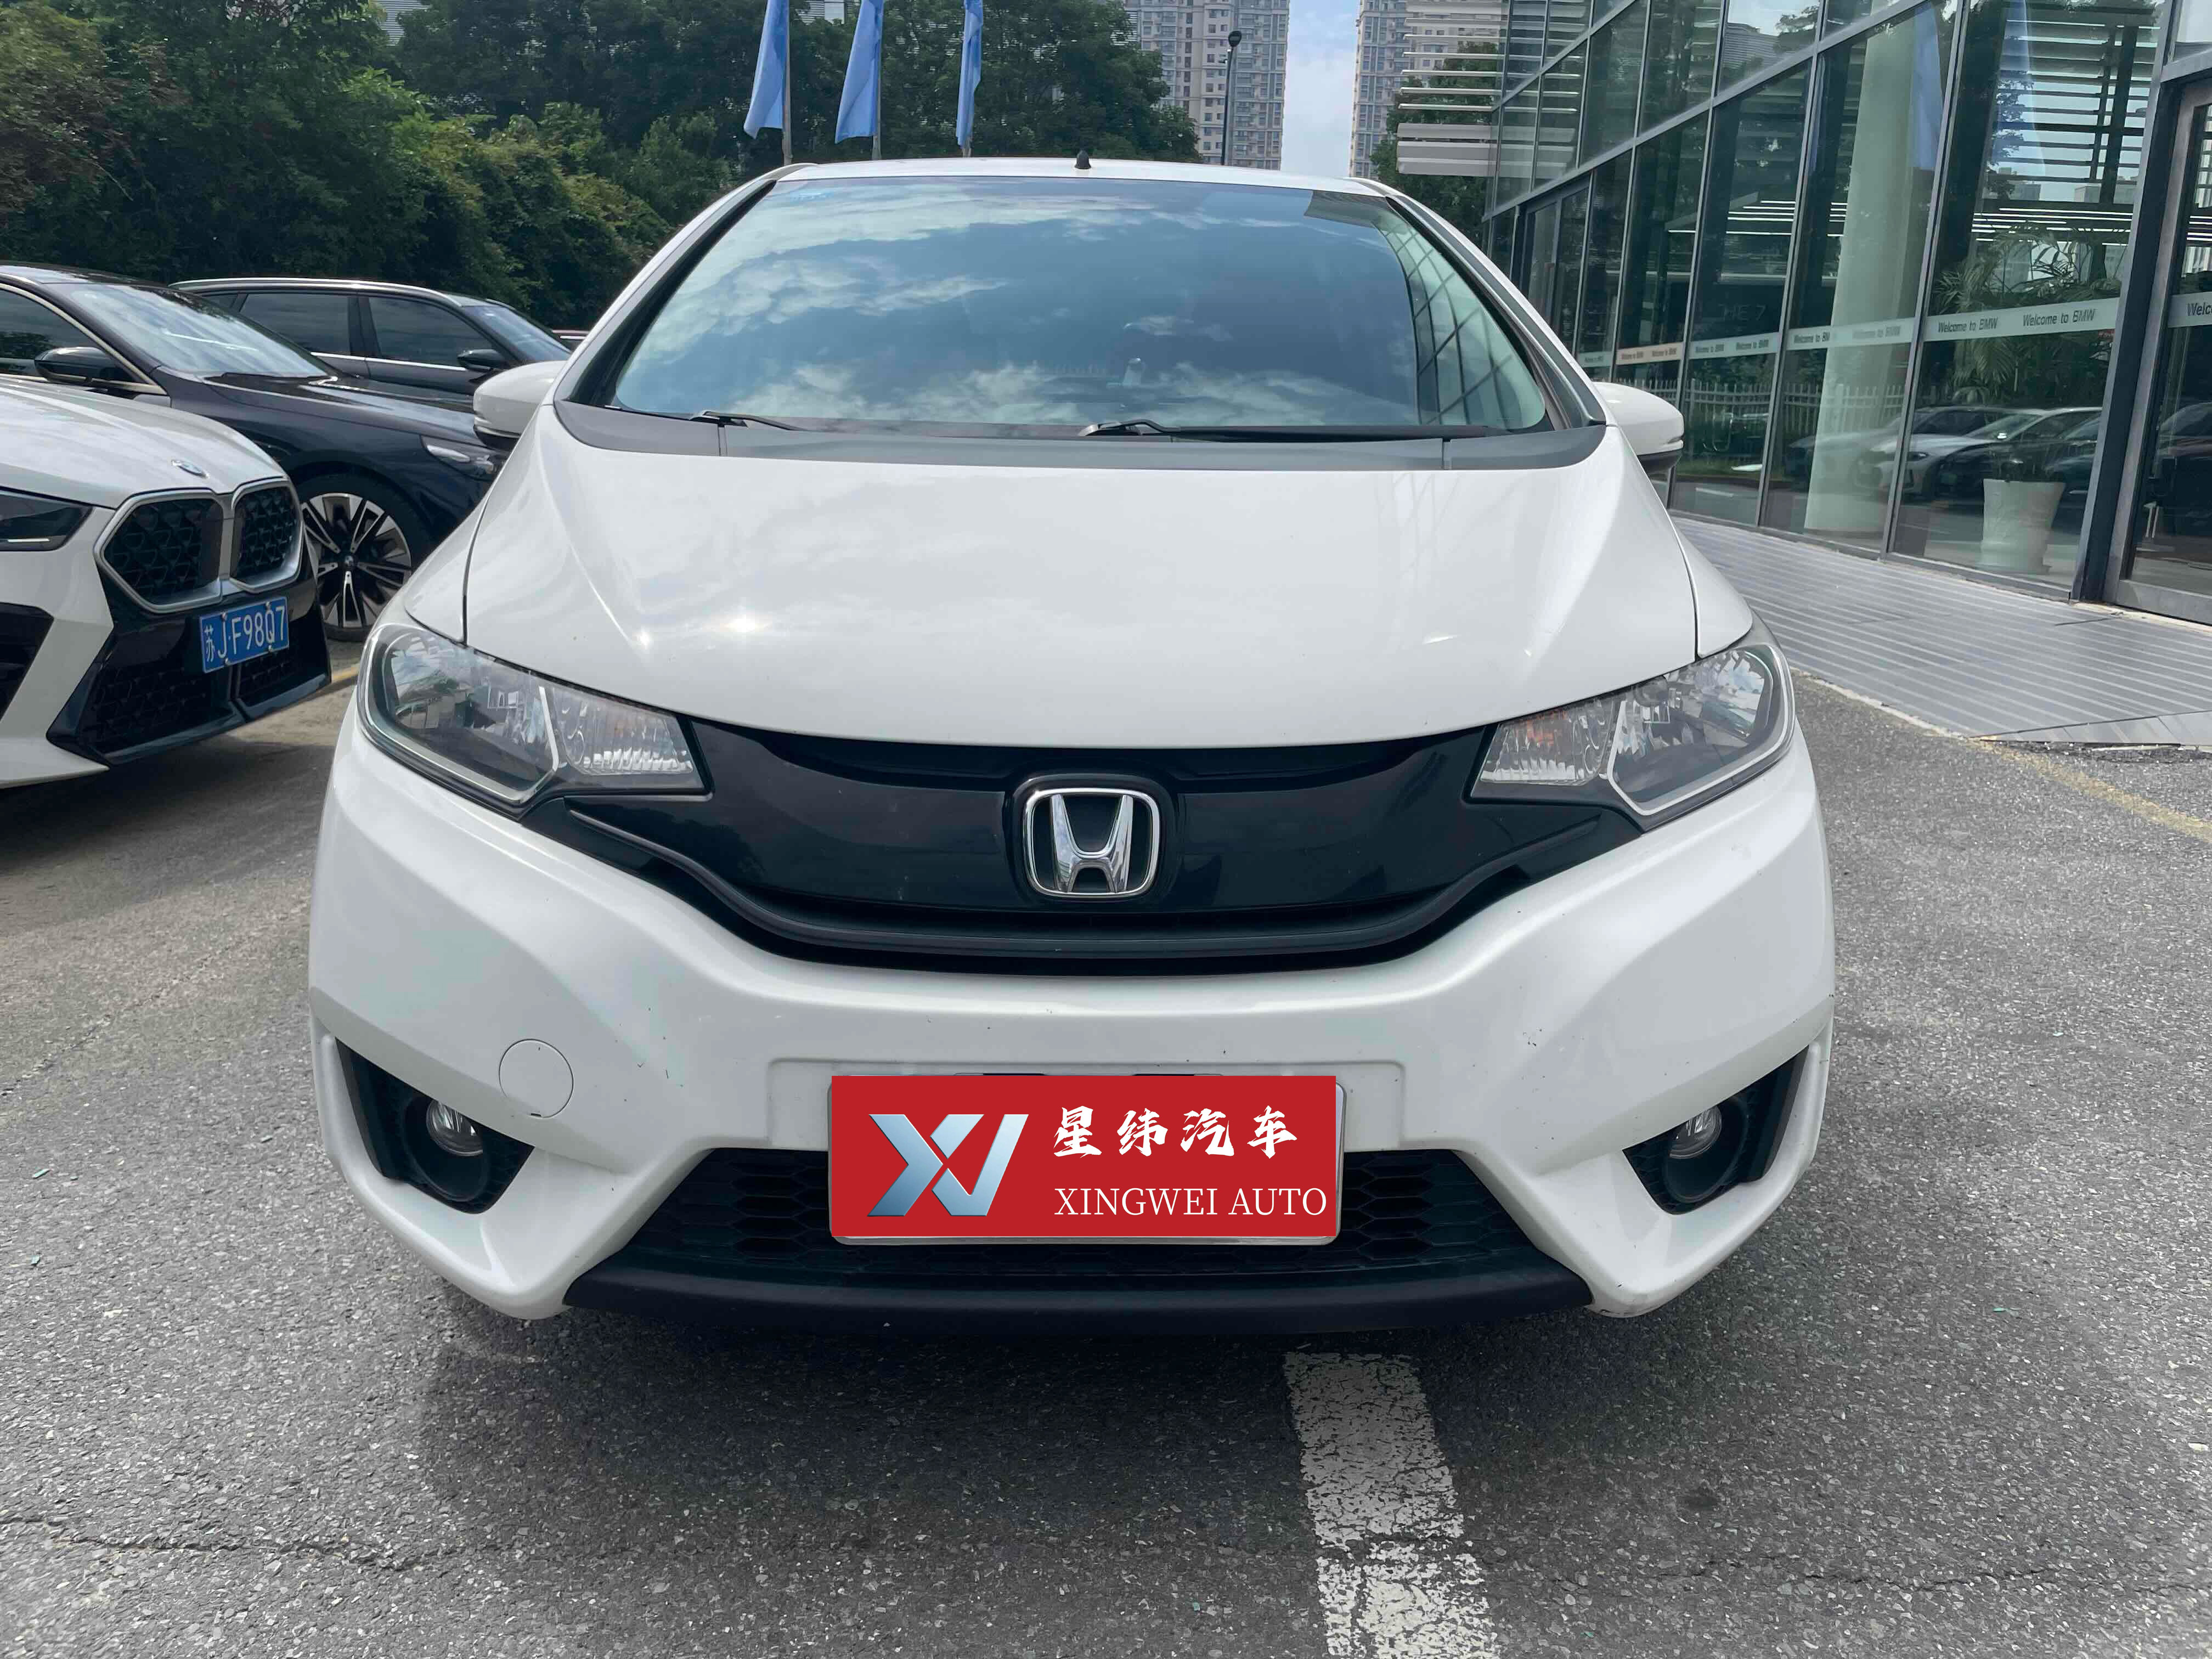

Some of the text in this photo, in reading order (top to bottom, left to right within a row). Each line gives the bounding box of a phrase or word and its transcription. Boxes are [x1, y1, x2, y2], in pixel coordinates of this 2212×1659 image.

[2023, 308, 2097, 327] Welcome to BMW
[2187, 302, 2212, 317] Welc
[1938, 315, 1998, 334] Welcome to BMW
